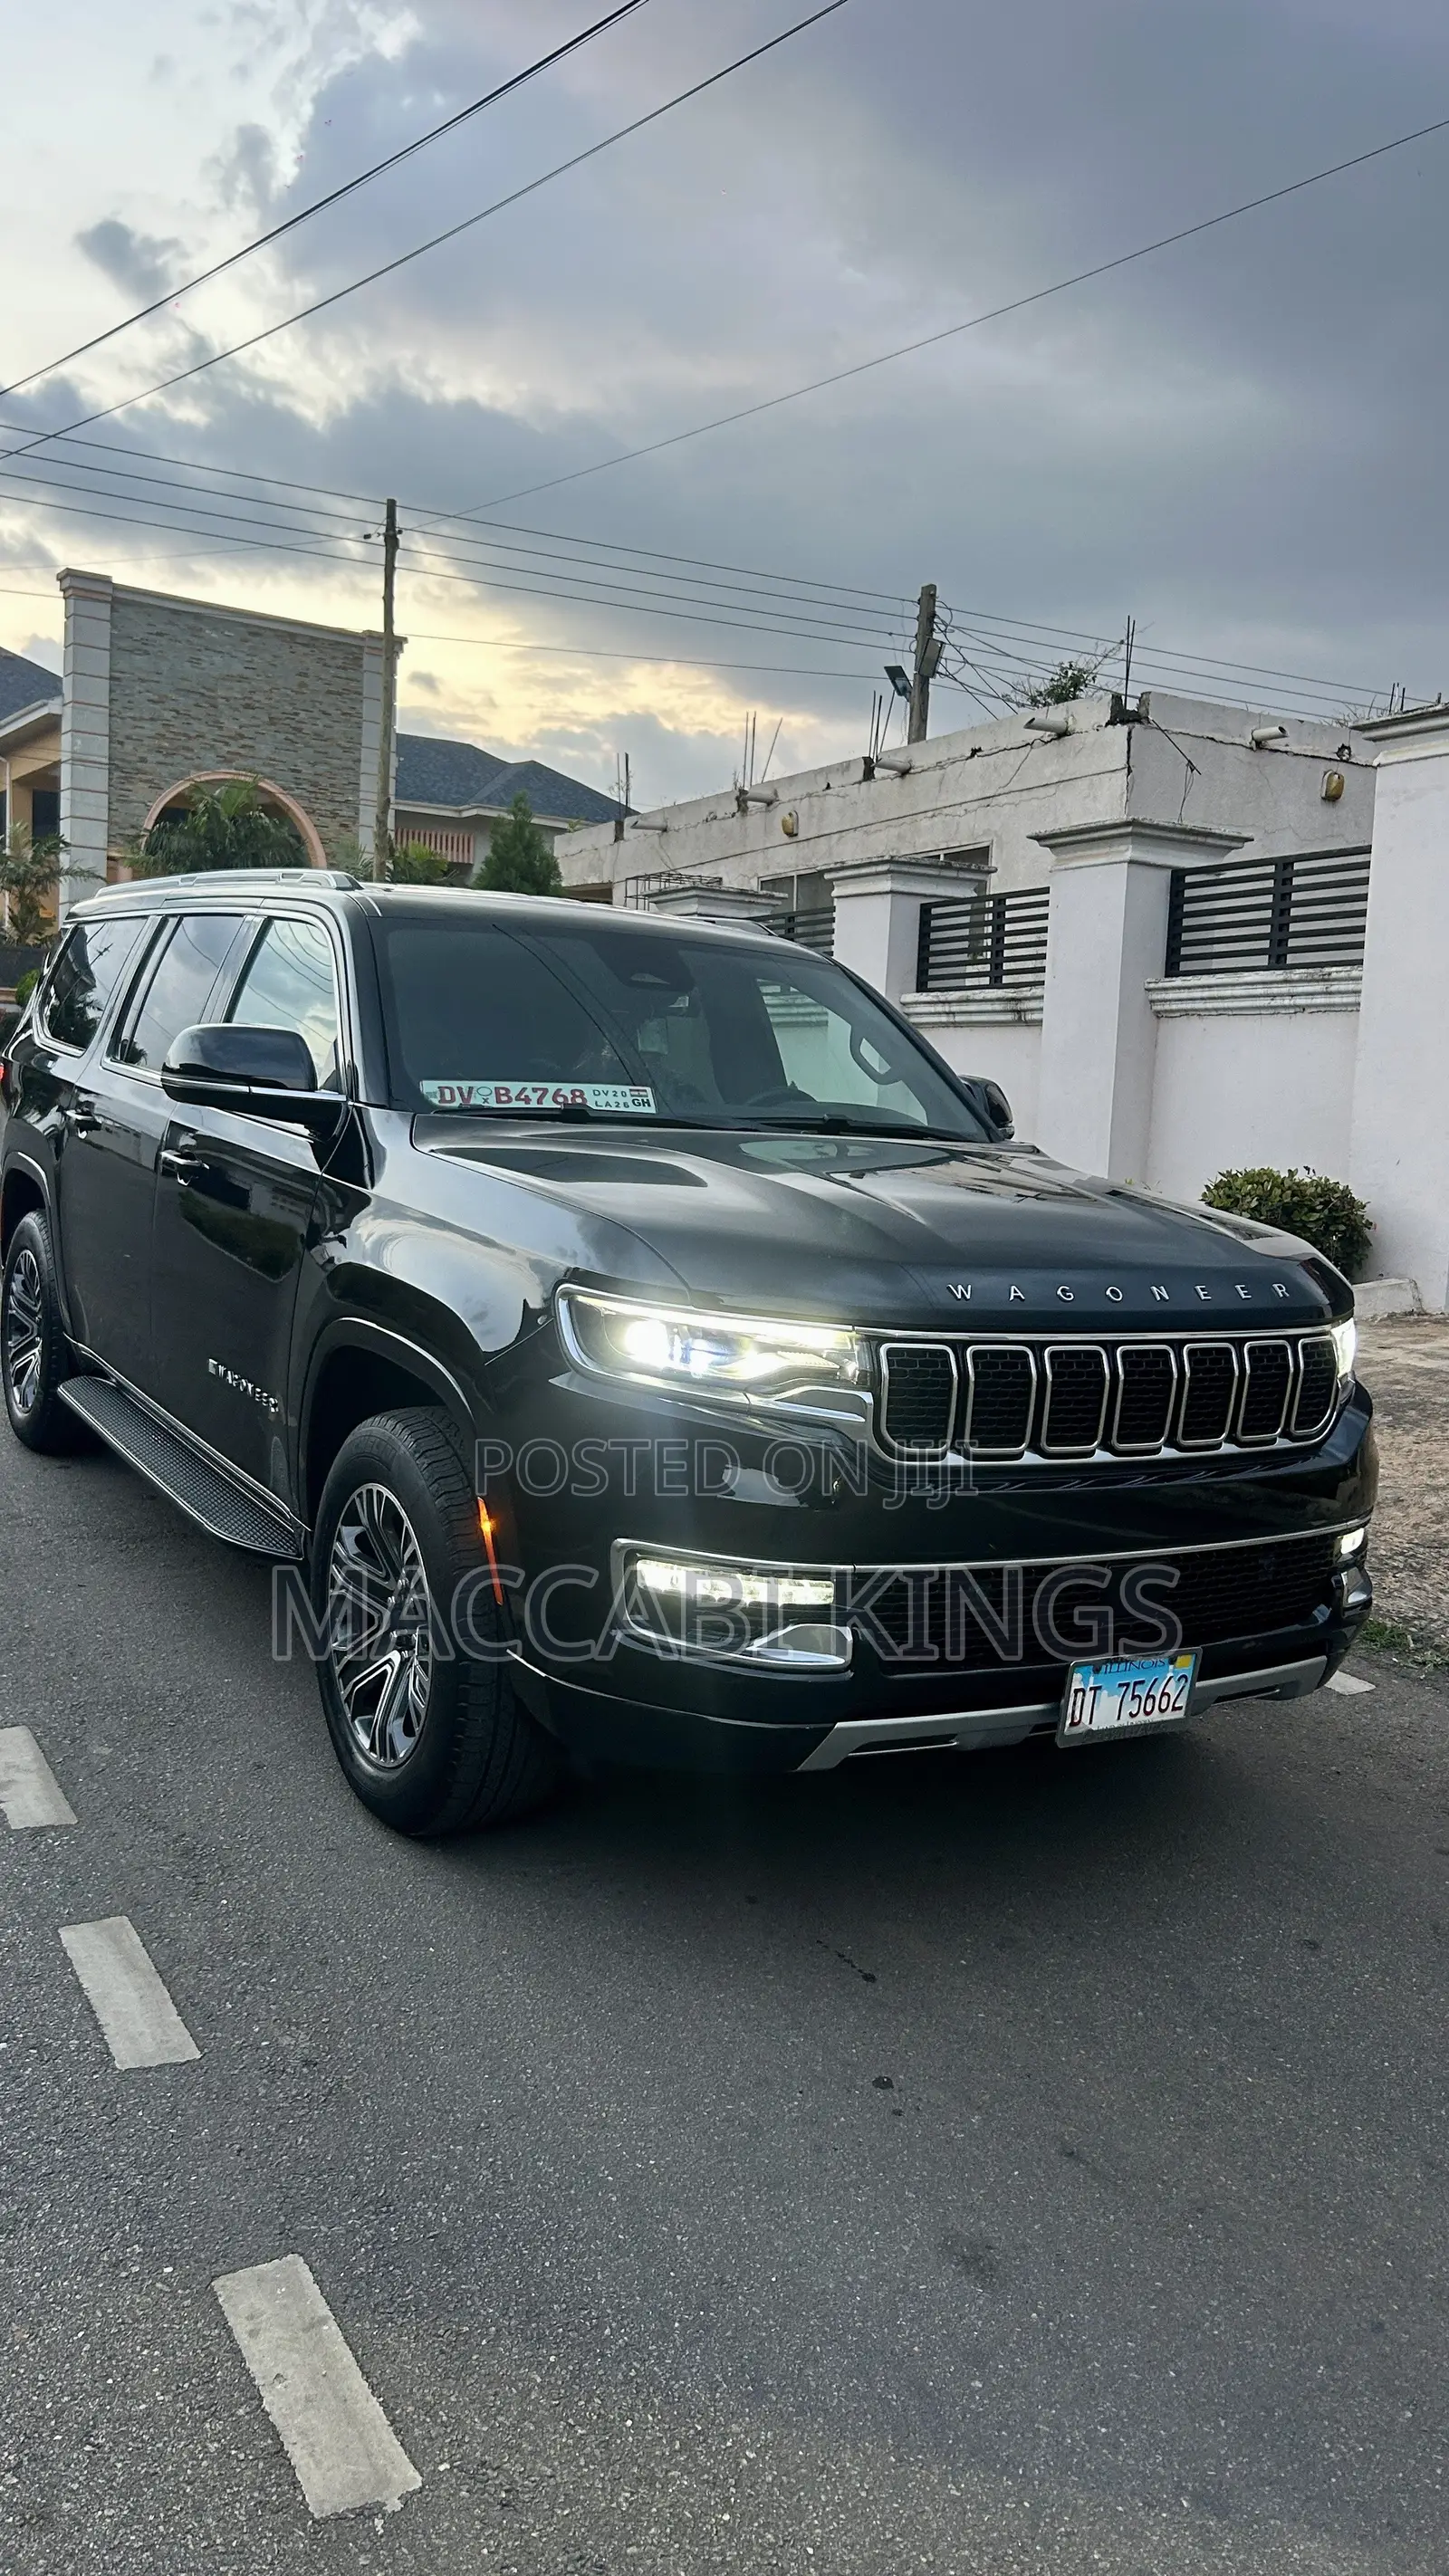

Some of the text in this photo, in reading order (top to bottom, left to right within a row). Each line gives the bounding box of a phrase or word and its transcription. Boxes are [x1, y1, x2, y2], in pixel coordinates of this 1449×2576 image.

[437, 1086, 474, 1104] DV
[494, 1086, 589, 1106] B4768
[631, 1098, 651, 1107] GH
[946, 1283, 1291, 1302] WAGONEER
[1104, 1656, 1166, 1674] ILLINOIS
[1069, 1674, 1188, 1727] DT 75662
